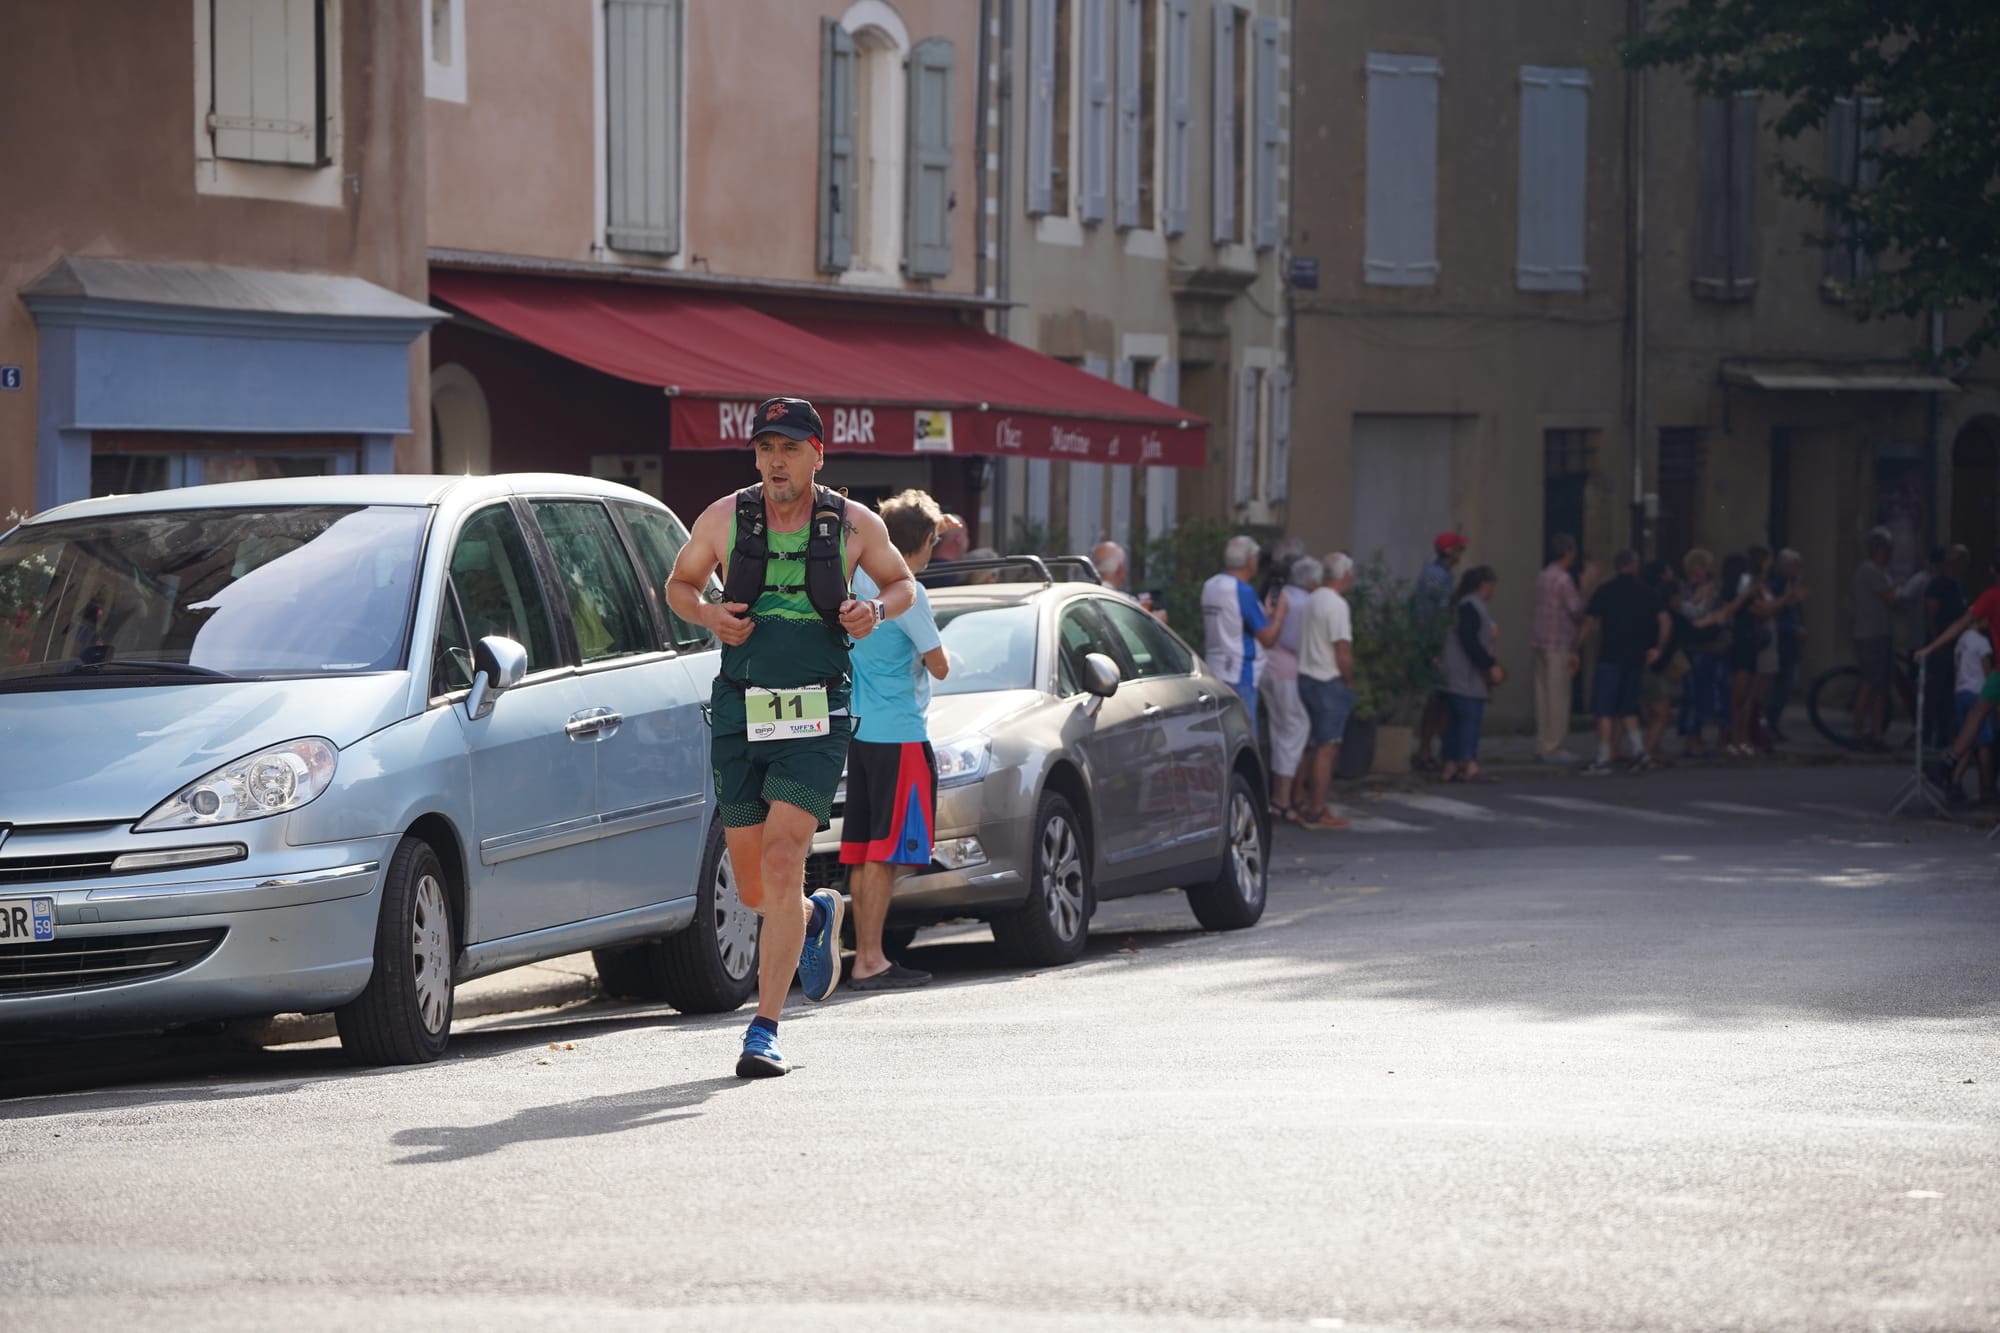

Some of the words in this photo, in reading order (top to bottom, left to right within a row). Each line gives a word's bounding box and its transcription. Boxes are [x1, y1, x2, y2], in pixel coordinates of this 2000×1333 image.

[7, 369, 15, 386] 6
[832, 408, 876, 444] BAR
[996, 417, 1023, 448] Chez
[768, 695, 803, 720] 11
[35, 919, 51, 934] 59
